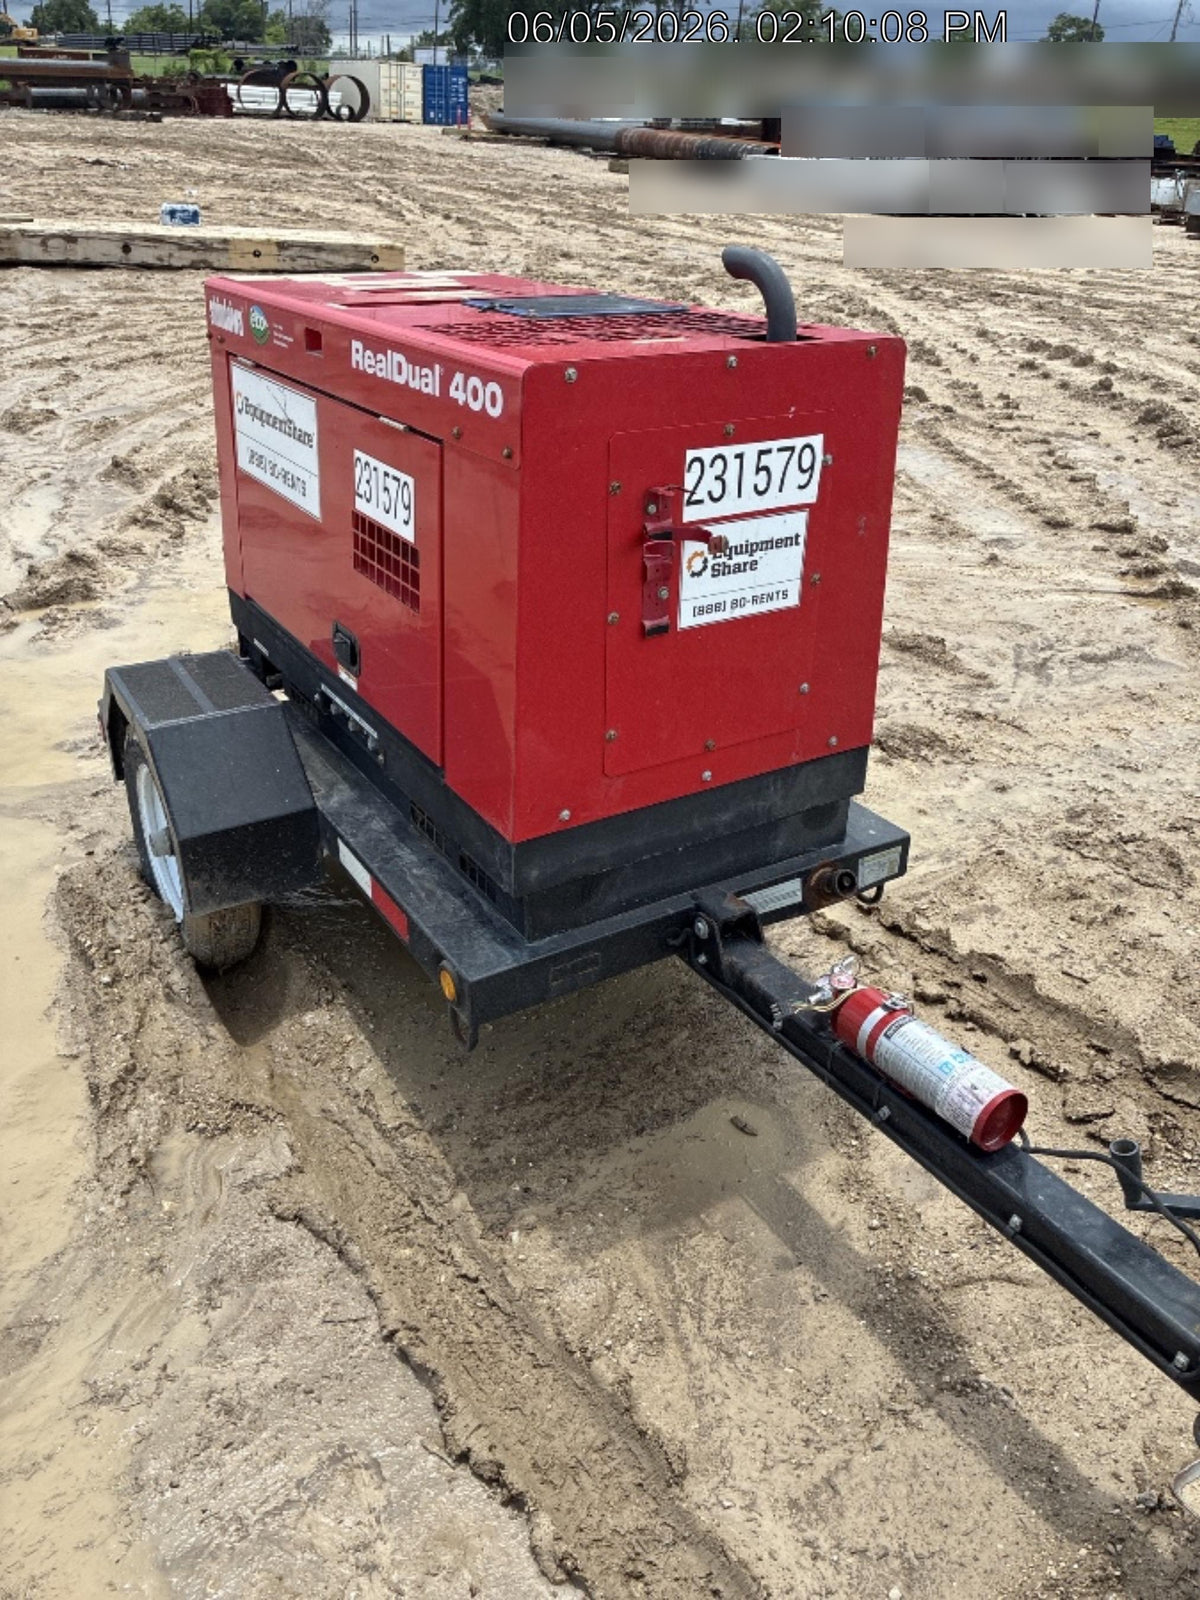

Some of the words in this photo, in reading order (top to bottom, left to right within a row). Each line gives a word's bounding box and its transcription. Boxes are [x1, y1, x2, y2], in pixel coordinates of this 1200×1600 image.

[352, 340, 440, 397] RealDual
[449, 372, 504, 418] 400
[355, 456, 412, 526] 231579
[686, 442, 816, 507] 231579
[711, 559, 758, 578] Share
[730, 589, 788, 609] 80-RENTS
